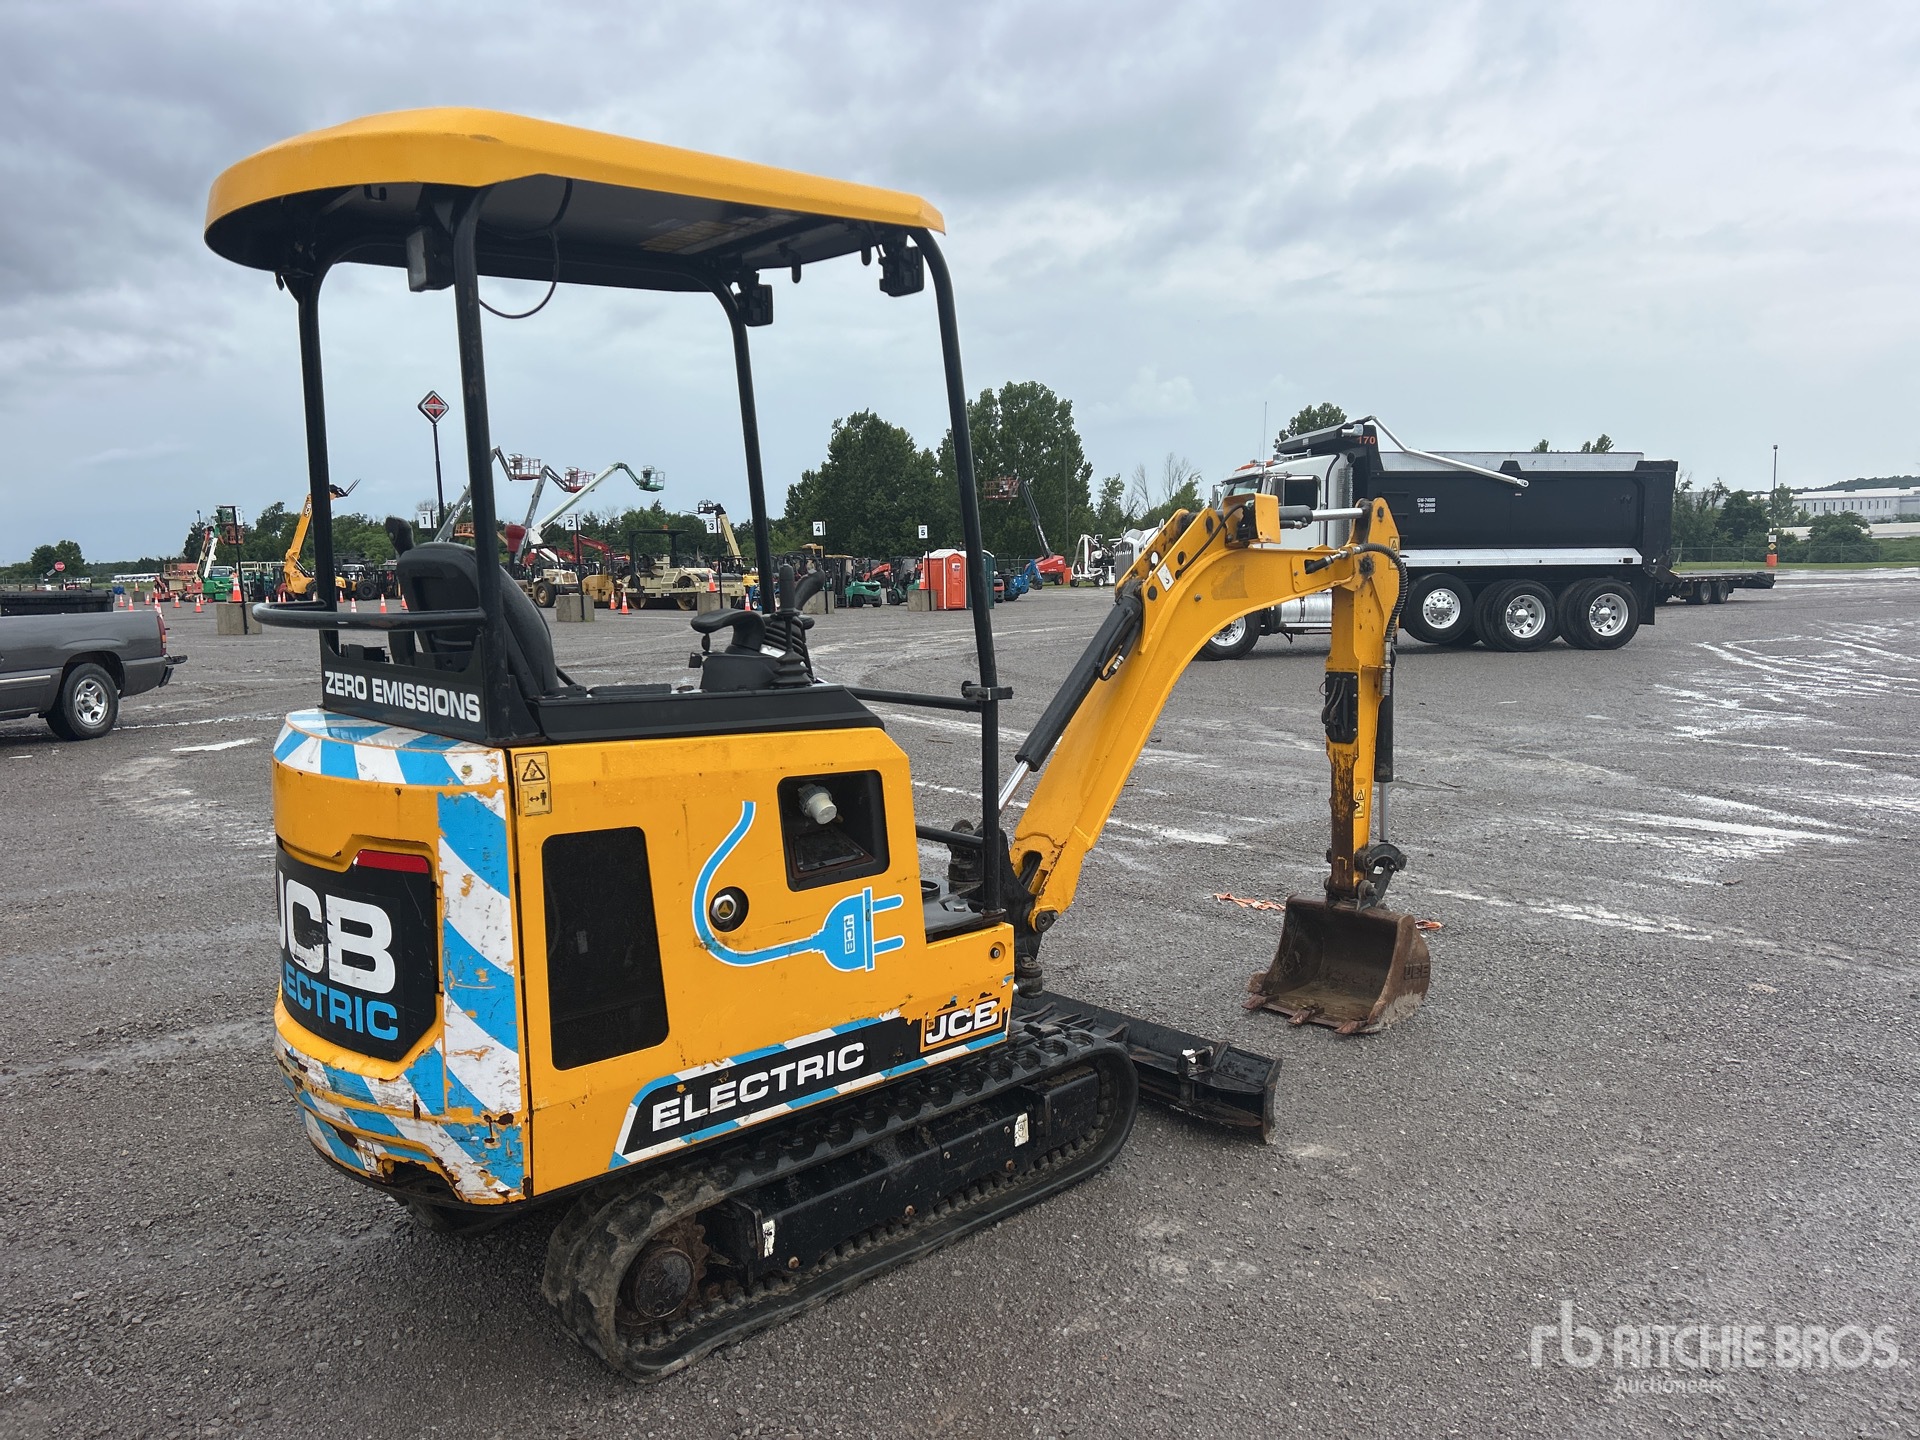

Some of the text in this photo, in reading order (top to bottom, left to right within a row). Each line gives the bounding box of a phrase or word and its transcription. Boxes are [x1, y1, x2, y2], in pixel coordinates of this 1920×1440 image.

[1358, 435, 1376, 445] 170
[422, 516, 427, 525] 1
[567, 519, 574, 527] 2
[709, 522, 715, 531] 3
[815, 525, 821, 533] 4
[324, 670, 482, 723] ZERO EMISSIONS
[845, 918, 854, 953] JCB
[925, 1000, 999, 1044] JCB
[652, 1041, 866, 1132] ELECTRIC
